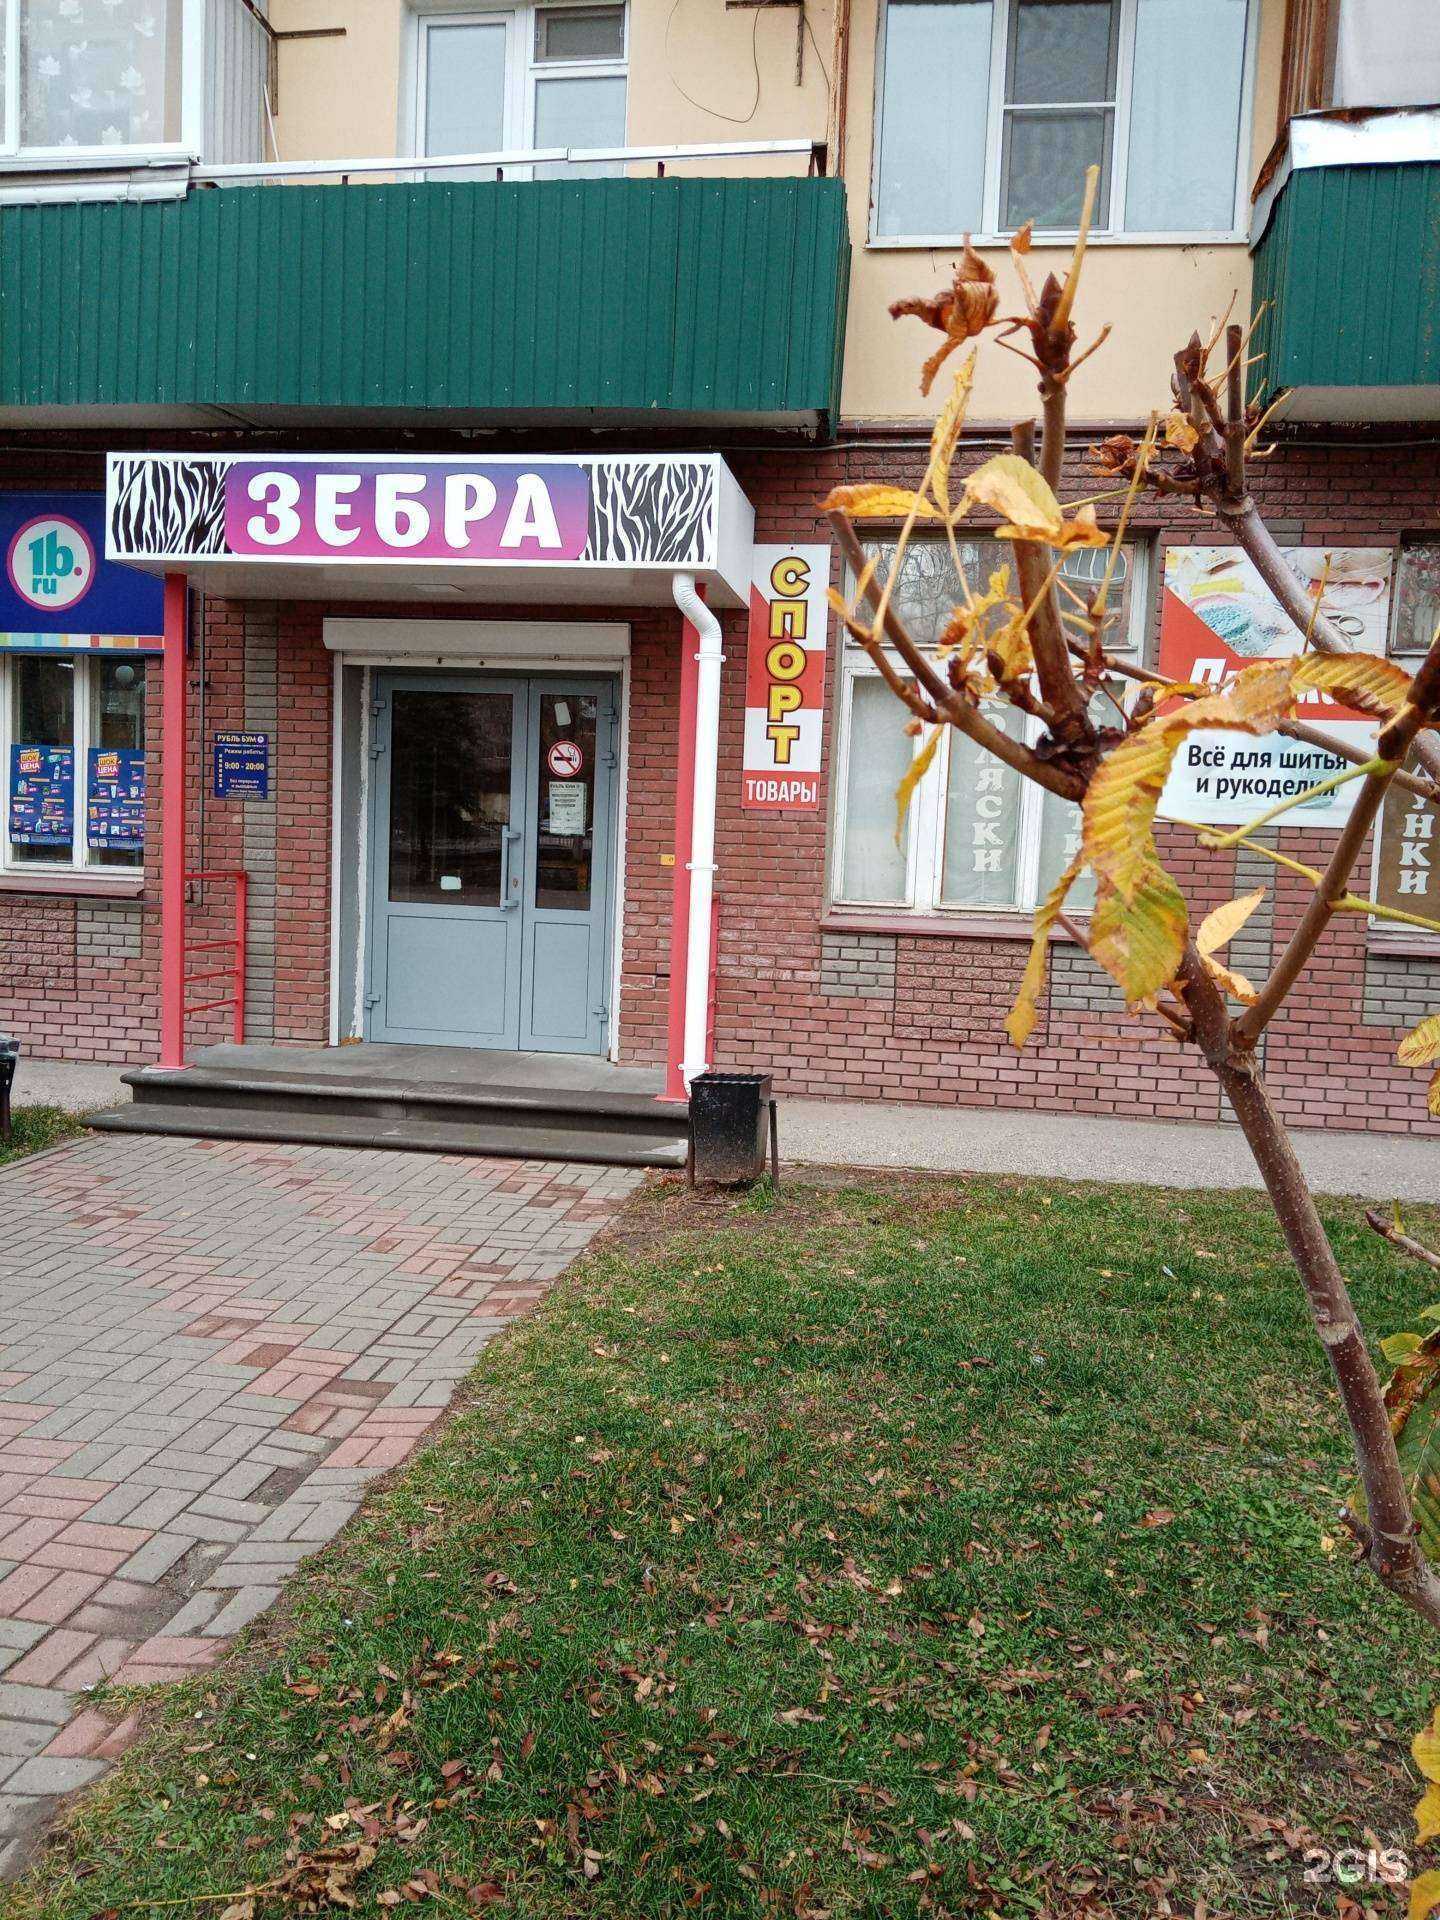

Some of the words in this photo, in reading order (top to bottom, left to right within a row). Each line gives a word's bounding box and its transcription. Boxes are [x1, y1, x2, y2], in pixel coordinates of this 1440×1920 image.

[247, 471, 563, 549] ЗЕБРА
[32, 578, 58, 595] ru
[765, 556, 812, 764] СПОРТ
[217, 734, 240, 743] РУБЛЬ
[241, 735, 257, 743] БУМ
[224, 761, 240, 770] 9:00
[245, 762, 265, 771] 20:00
[1187, 744, 1226, 767] Всё
[1230, 751, 1272, 771] для
[1279, 752, 1348, 770] шитья
[745, 780, 817, 804] ТОВАРЫ
[1196, 777, 1209, 793] и
